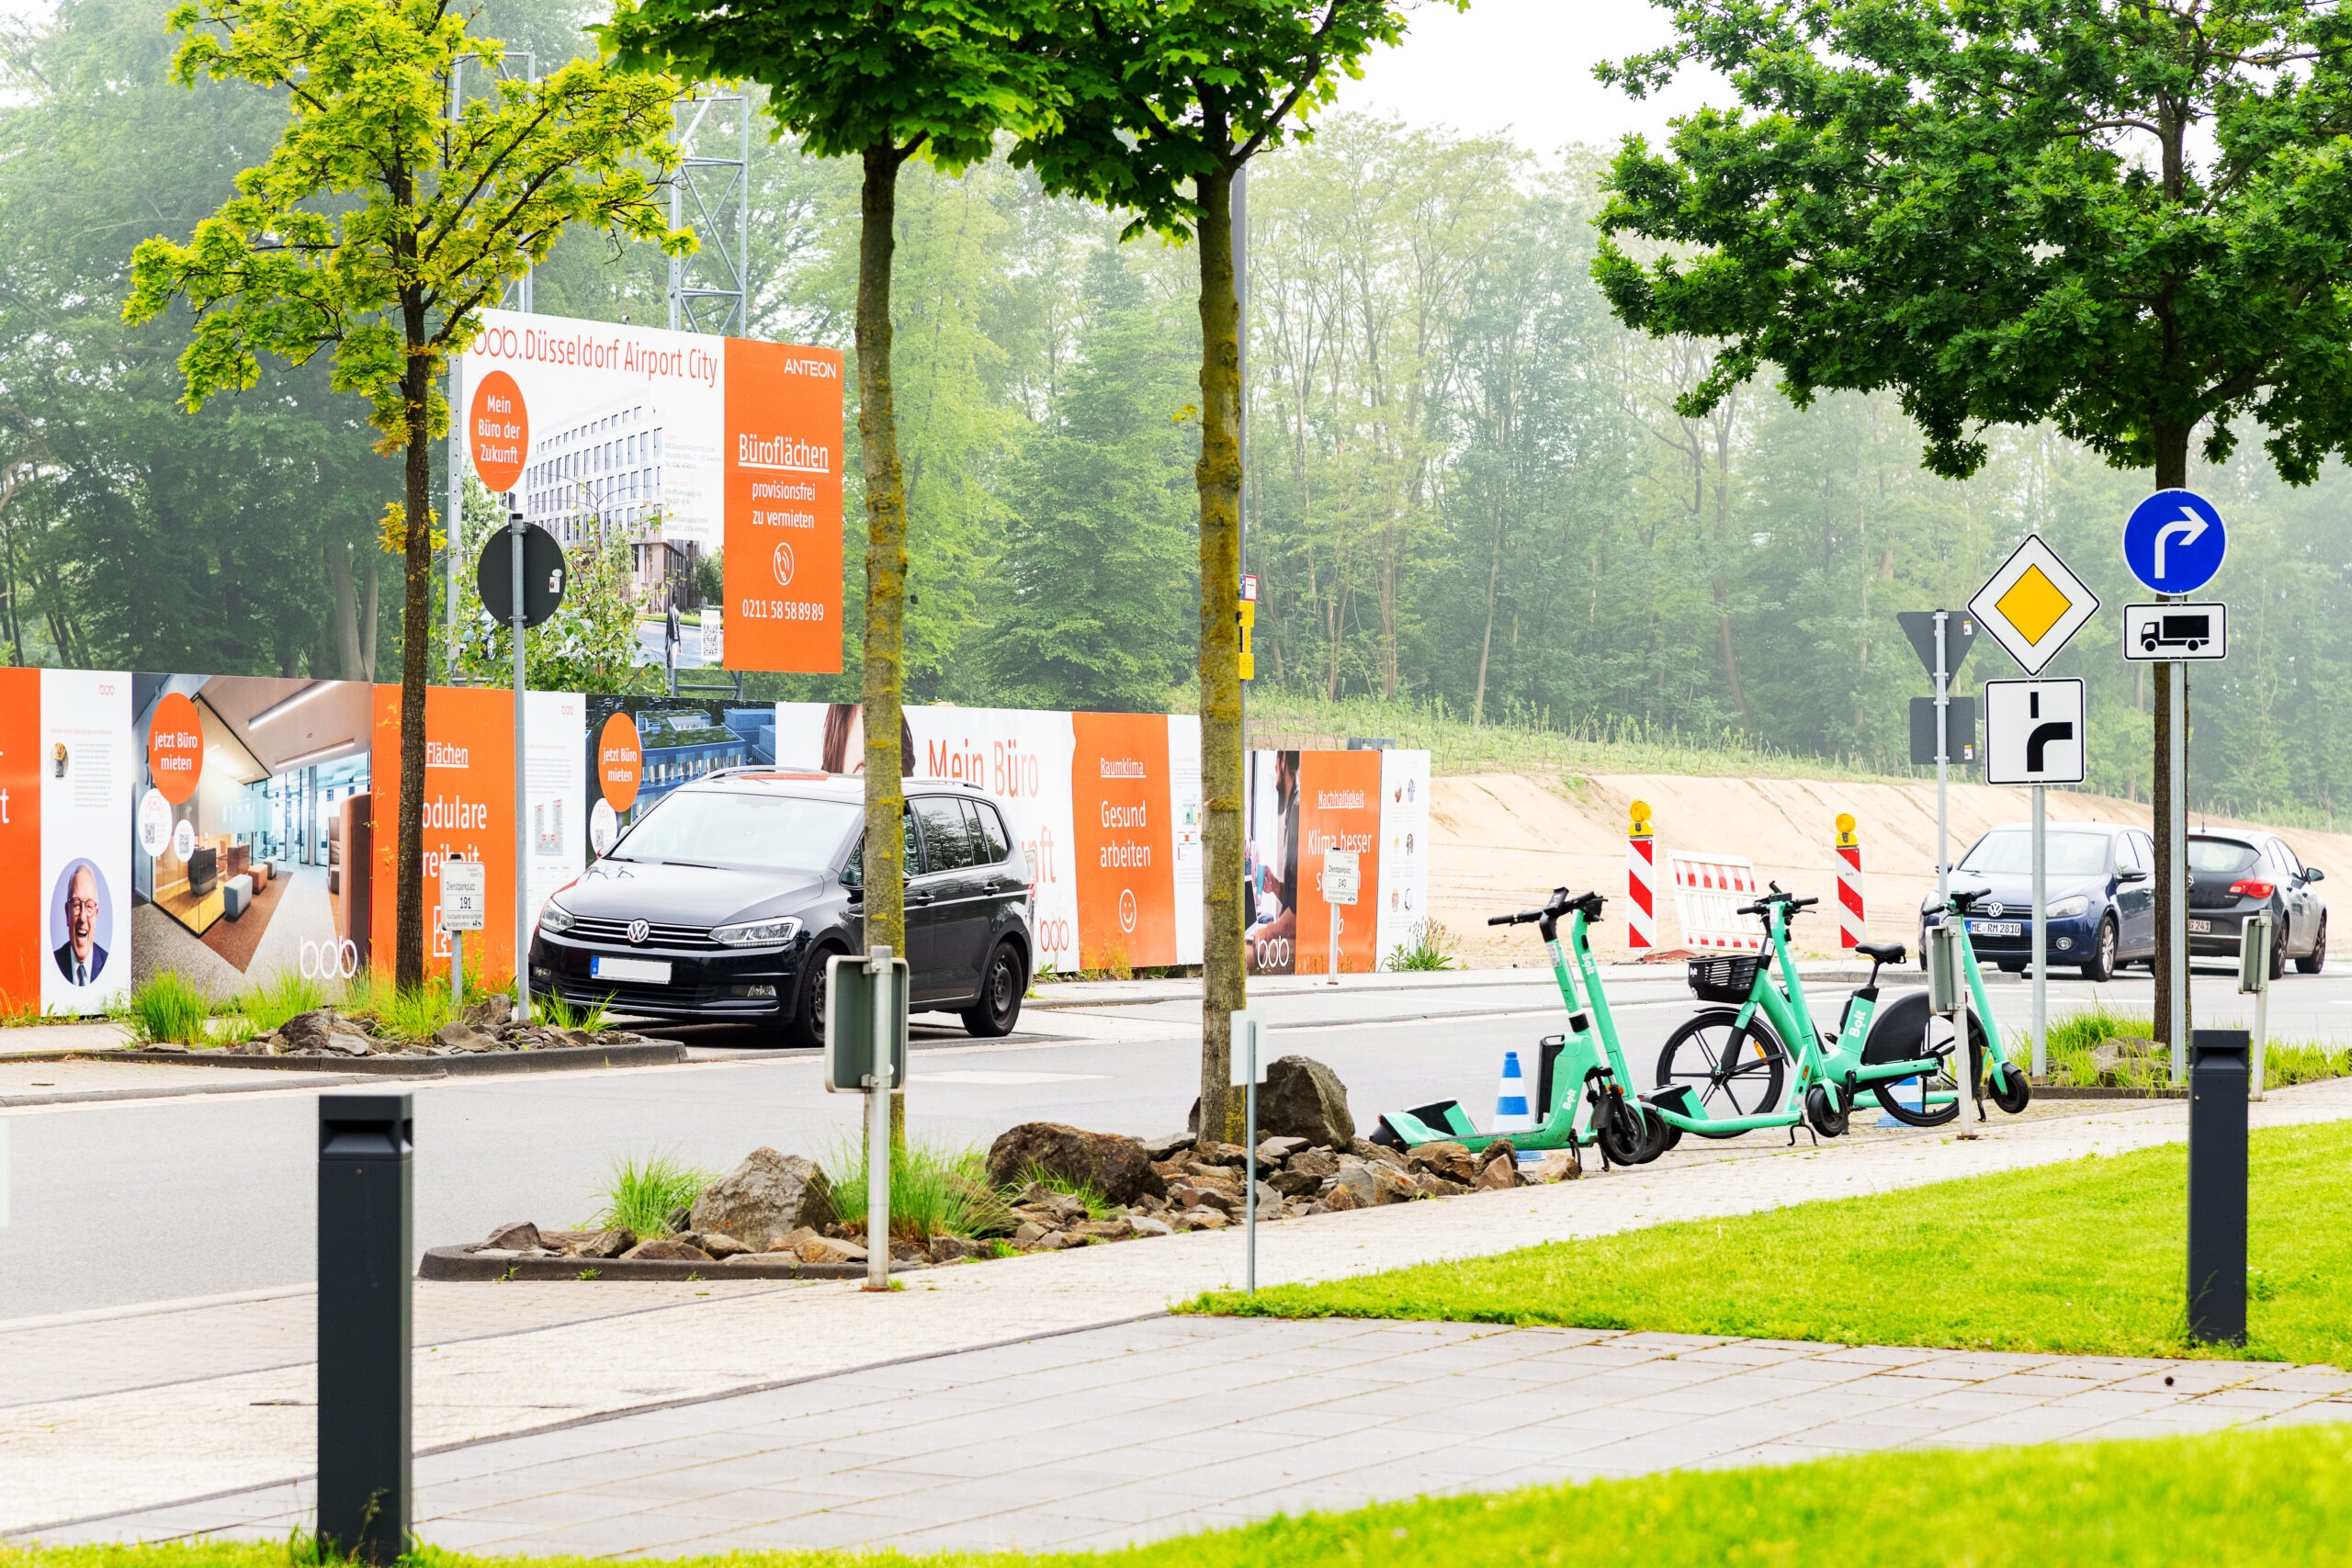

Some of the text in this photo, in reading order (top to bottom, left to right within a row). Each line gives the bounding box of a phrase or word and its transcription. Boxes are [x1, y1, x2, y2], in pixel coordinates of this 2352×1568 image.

[624, 341, 683, 381] Airport
[689, 348, 718, 389] City
[784, 358, 837, 379] ANTEON
[487, 394, 512, 413] Mein
[478, 418, 521, 439] Büro der
[481, 444, 519, 465] Zukunft
[739, 433, 829, 469] Büroflächen
[752, 481, 817, 502] provisionsfrei
[752, 508, 815, 529] zu vermieten
[741, 598, 768, 618] 0211
[154, 731, 198, 751] jetzt Büro
[161, 755, 192, 771] mieten
[426, 741, 469, 764] Flächen
[603, 747, 638, 764] jetzt Büro
[607, 767, 633, 783] mieten
[994, 739, 1039, 798] Büro
[1100, 757, 1144, 776] Raumklima
[1317, 790, 1364, 807] Nachhaltigkeit
[422, 795, 487, 829] odulare
[1101, 800, 1147, 829] Gesund
[1307, 829, 1373, 855] Klima besser
[1100, 840, 1151, 868] arbeiten
[460, 897, 471, 909] 191
[1972, 922, 1982, 932] ME
[1987, 923, 1998, 933] RM
[2195, 921, 2210, 931] 241
[300, 934, 358, 980] bob
[1257, 934, 1290, 969] bob
[1581, 953, 1597, 976] Bolt
[1848, 1010, 1867, 1039] Bolt
[1562, 1089, 1577, 1111] Bolt
